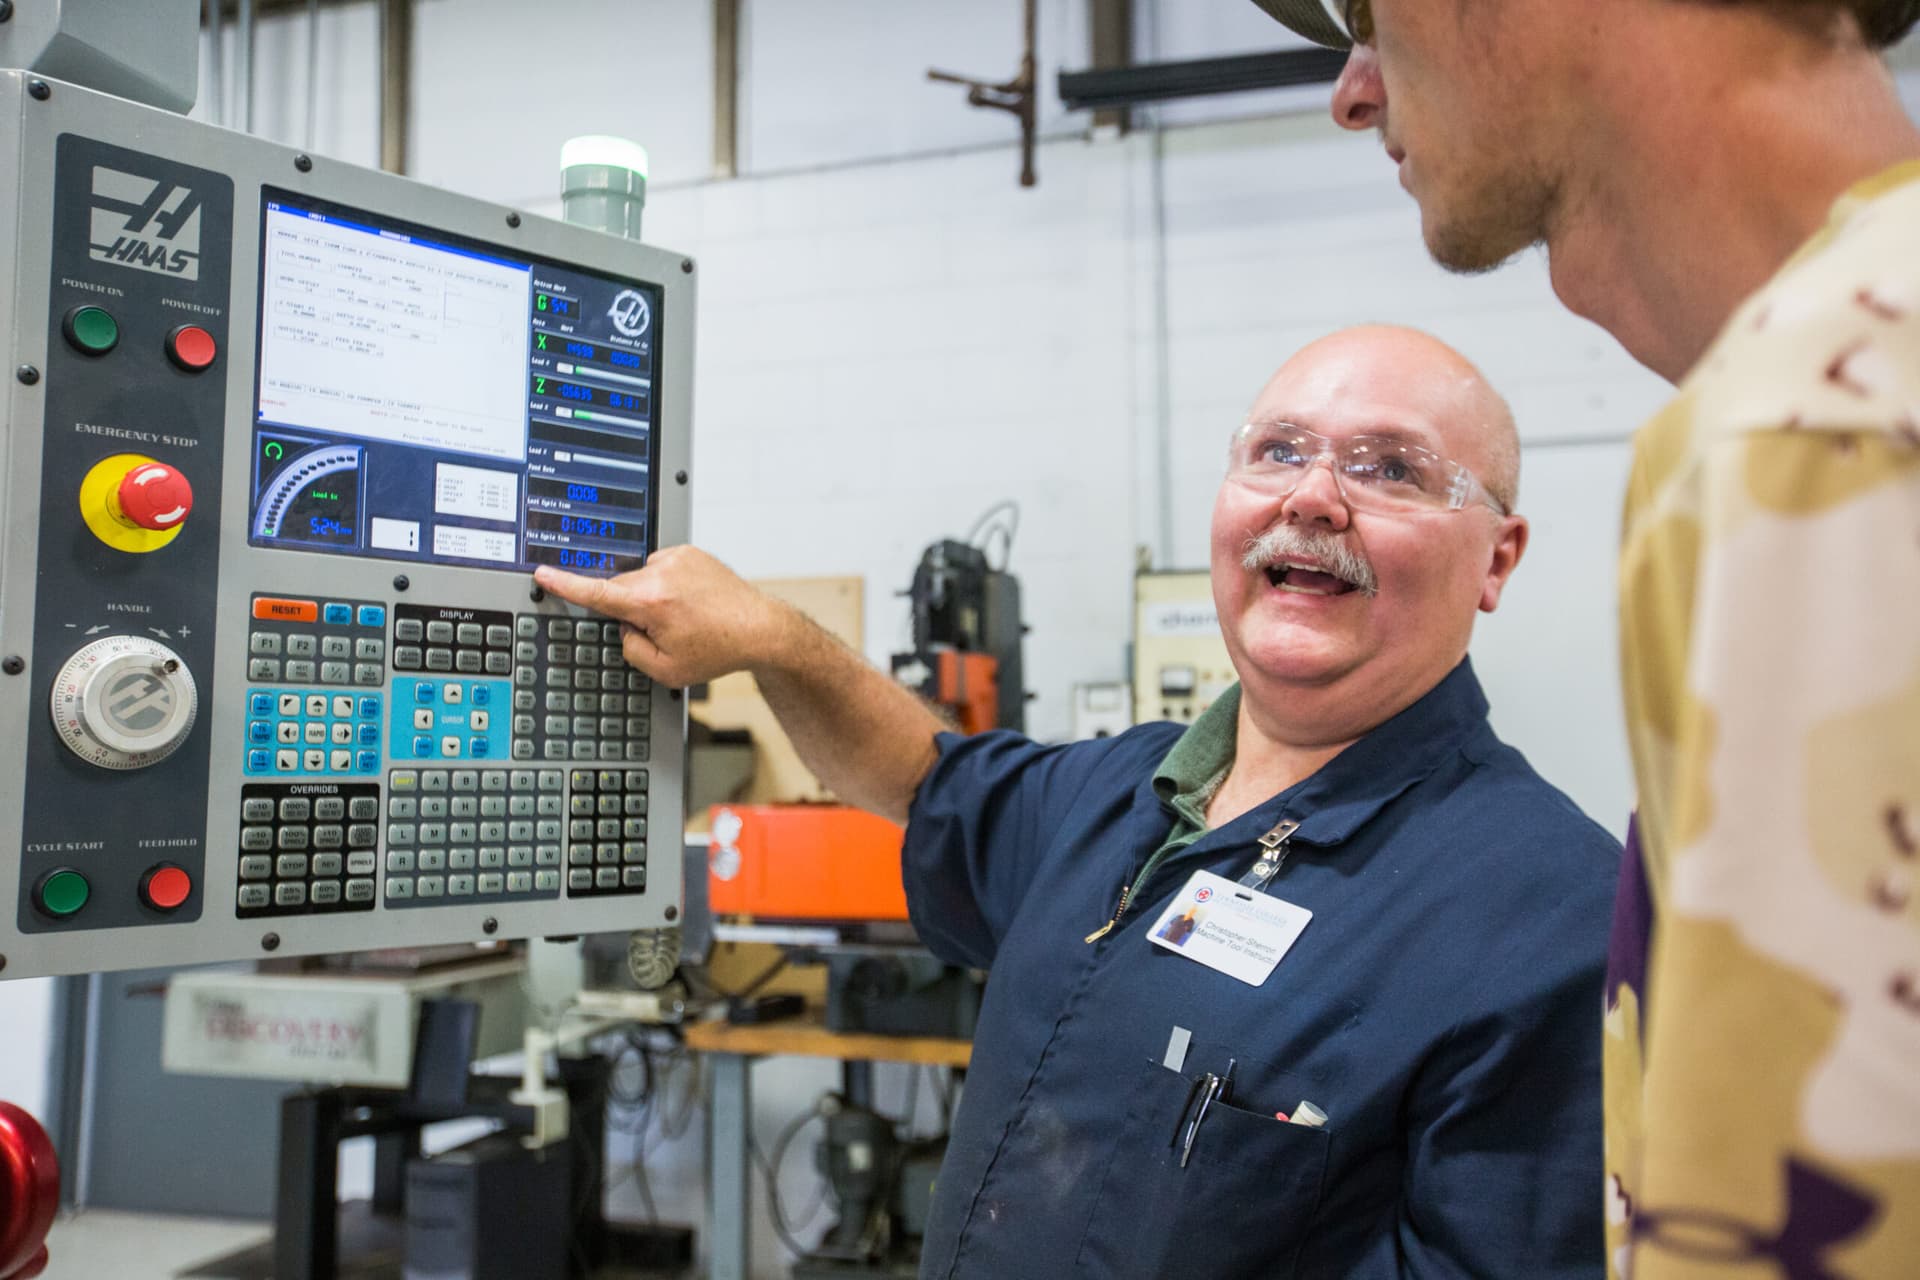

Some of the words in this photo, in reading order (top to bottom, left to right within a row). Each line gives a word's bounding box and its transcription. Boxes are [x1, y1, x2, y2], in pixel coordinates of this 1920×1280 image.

[90, 236, 200, 274] HAAS
[61, 277, 106, 294] POWER
[106, 288, 124, 297] ON
[537, 294, 547, 311] G
[162, 298, 202, 313] POWER
[202, 306, 222, 317] OFF
[537, 334, 547, 350] X
[536, 377, 545, 394] Z
[75, 423, 159, 443] EMERGENCY
[162, 434, 198, 447] STOP
[107, 602, 152, 614] HANDLE
[271, 604, 302, 616] RESET
[440, 610, 473, 620] DISPLAY
[262, 639, 273, 648] F1
[297, 640, 309, 650] F2
[331, 642, 343, 652] F3
[365, 644, 376, 654] F4
[433, 777, 440, 785] A
[463, 777, 469, 785] B
[492, 776, 499, 785] C
[521, 776, 527, 785] D
[548, 776, 555, 785] E
[582, 776, 588, 785] 7
[609, 776, 615, 785] 8
[290, 785, 338, 794] OVERRIDES
[401, 803, 407, 812] F
[431, 803, 439, 812] G
[462, 803, 469, 811] H
[520, 800, 526, 809] J
[548, 801, 554, 809] K
[581, 800, 587, 809] 4
[461, 829, 468, 837] N
[520, 827, 526, 836] P
[547, 826, 554, 835] Q
[582, 824, 586, 835] 1
[607, 824, 614, 833] 2
[634, 824, 640, 833] 3
[400, 830, 406, 839] L
[430, 829, 439, 838] M
[26, 842, 62, 853] CYCLE
[66, 841, 105, 852] START
[138, 839, 166, 849] FEED
[168, 838, 197, 848] HOLD
[399, 856, 406, 864] R
[430, 856, 437, 864] S
[461, 854, 466, 863] T
[490, 853, 496, 862] U
[518, 852, 525, 861] V
[545, 851, 554, 860] W
[398, 883, 404, 892] X
[429, 882, 435, 892] Y
[459, 881, 466, 889] Z
[1227, 940, 1242, 951] Tool
